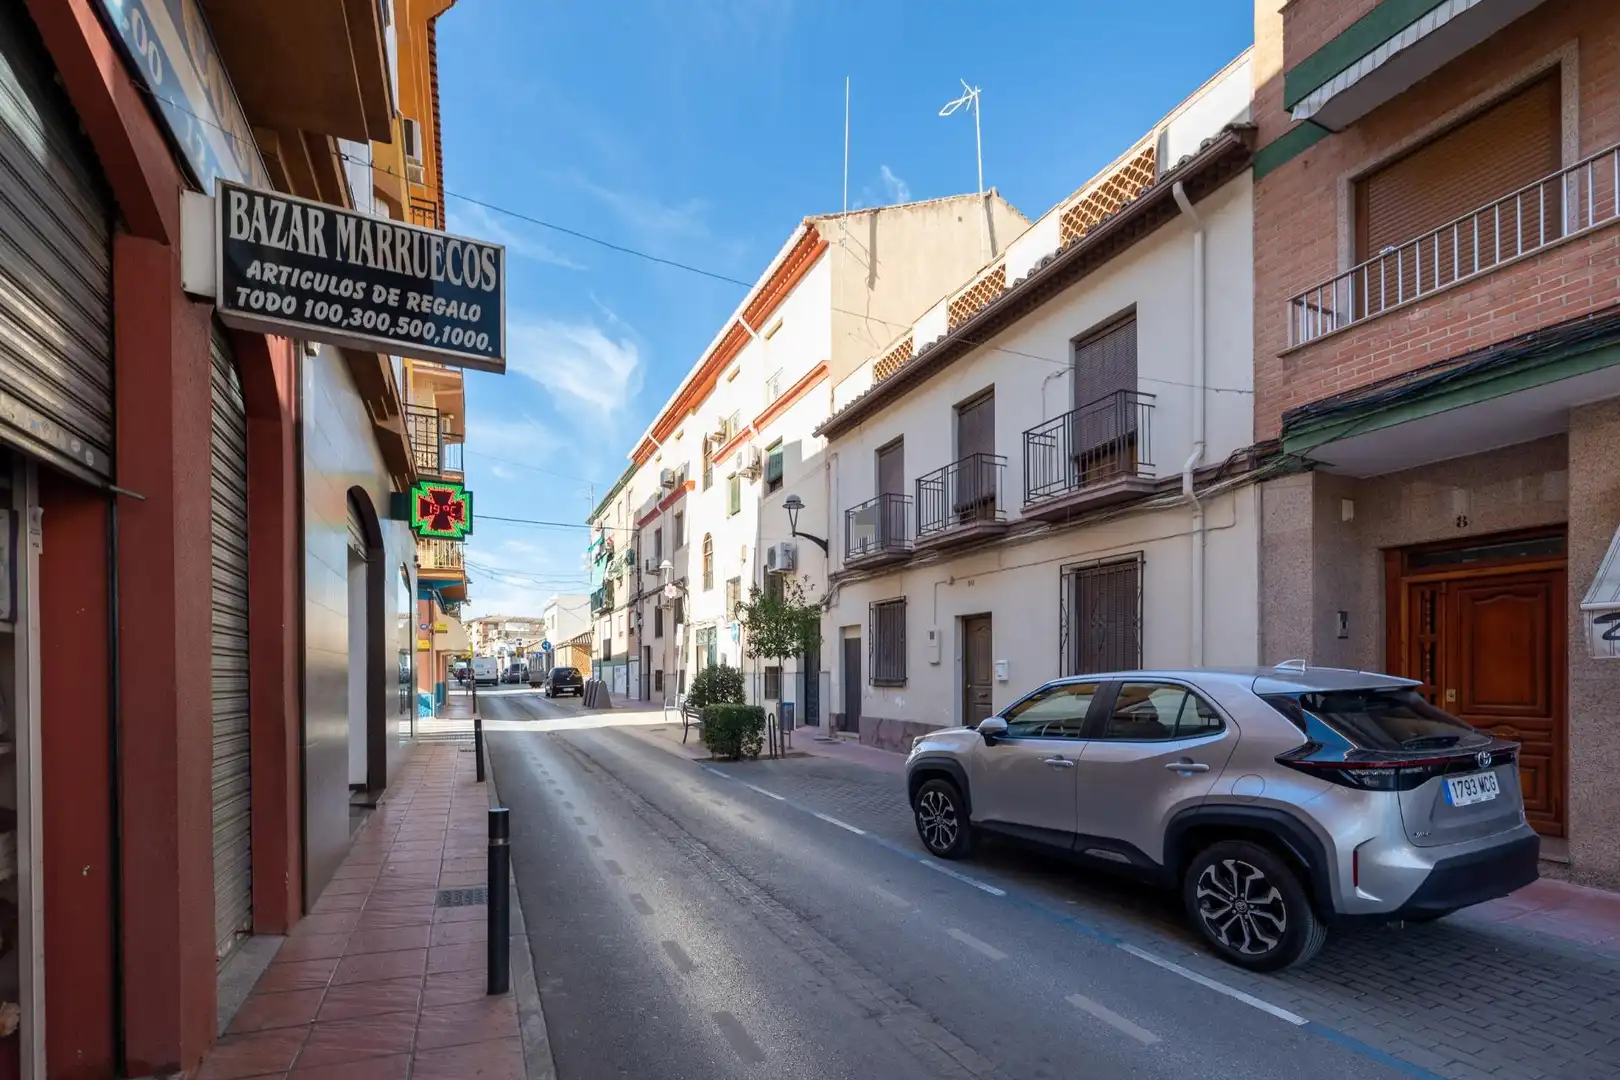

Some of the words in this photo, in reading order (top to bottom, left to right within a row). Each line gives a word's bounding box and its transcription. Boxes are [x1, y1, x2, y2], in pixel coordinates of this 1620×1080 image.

[229, 190, 328, 259] BAZAR
[336, 214, 497, 293] MARRUECOS
[236, 286, 297, 315] TODO
[246, 259, 367, 301] ARTICULOS
[372, 283, 400, 307] DE
[406, 291, 481, 323] REGALO
[1456, 515, 1469, 528] 8
[1452, 779, 1477, 798] 1793
[1478, 776, 1496, 793] MCG
